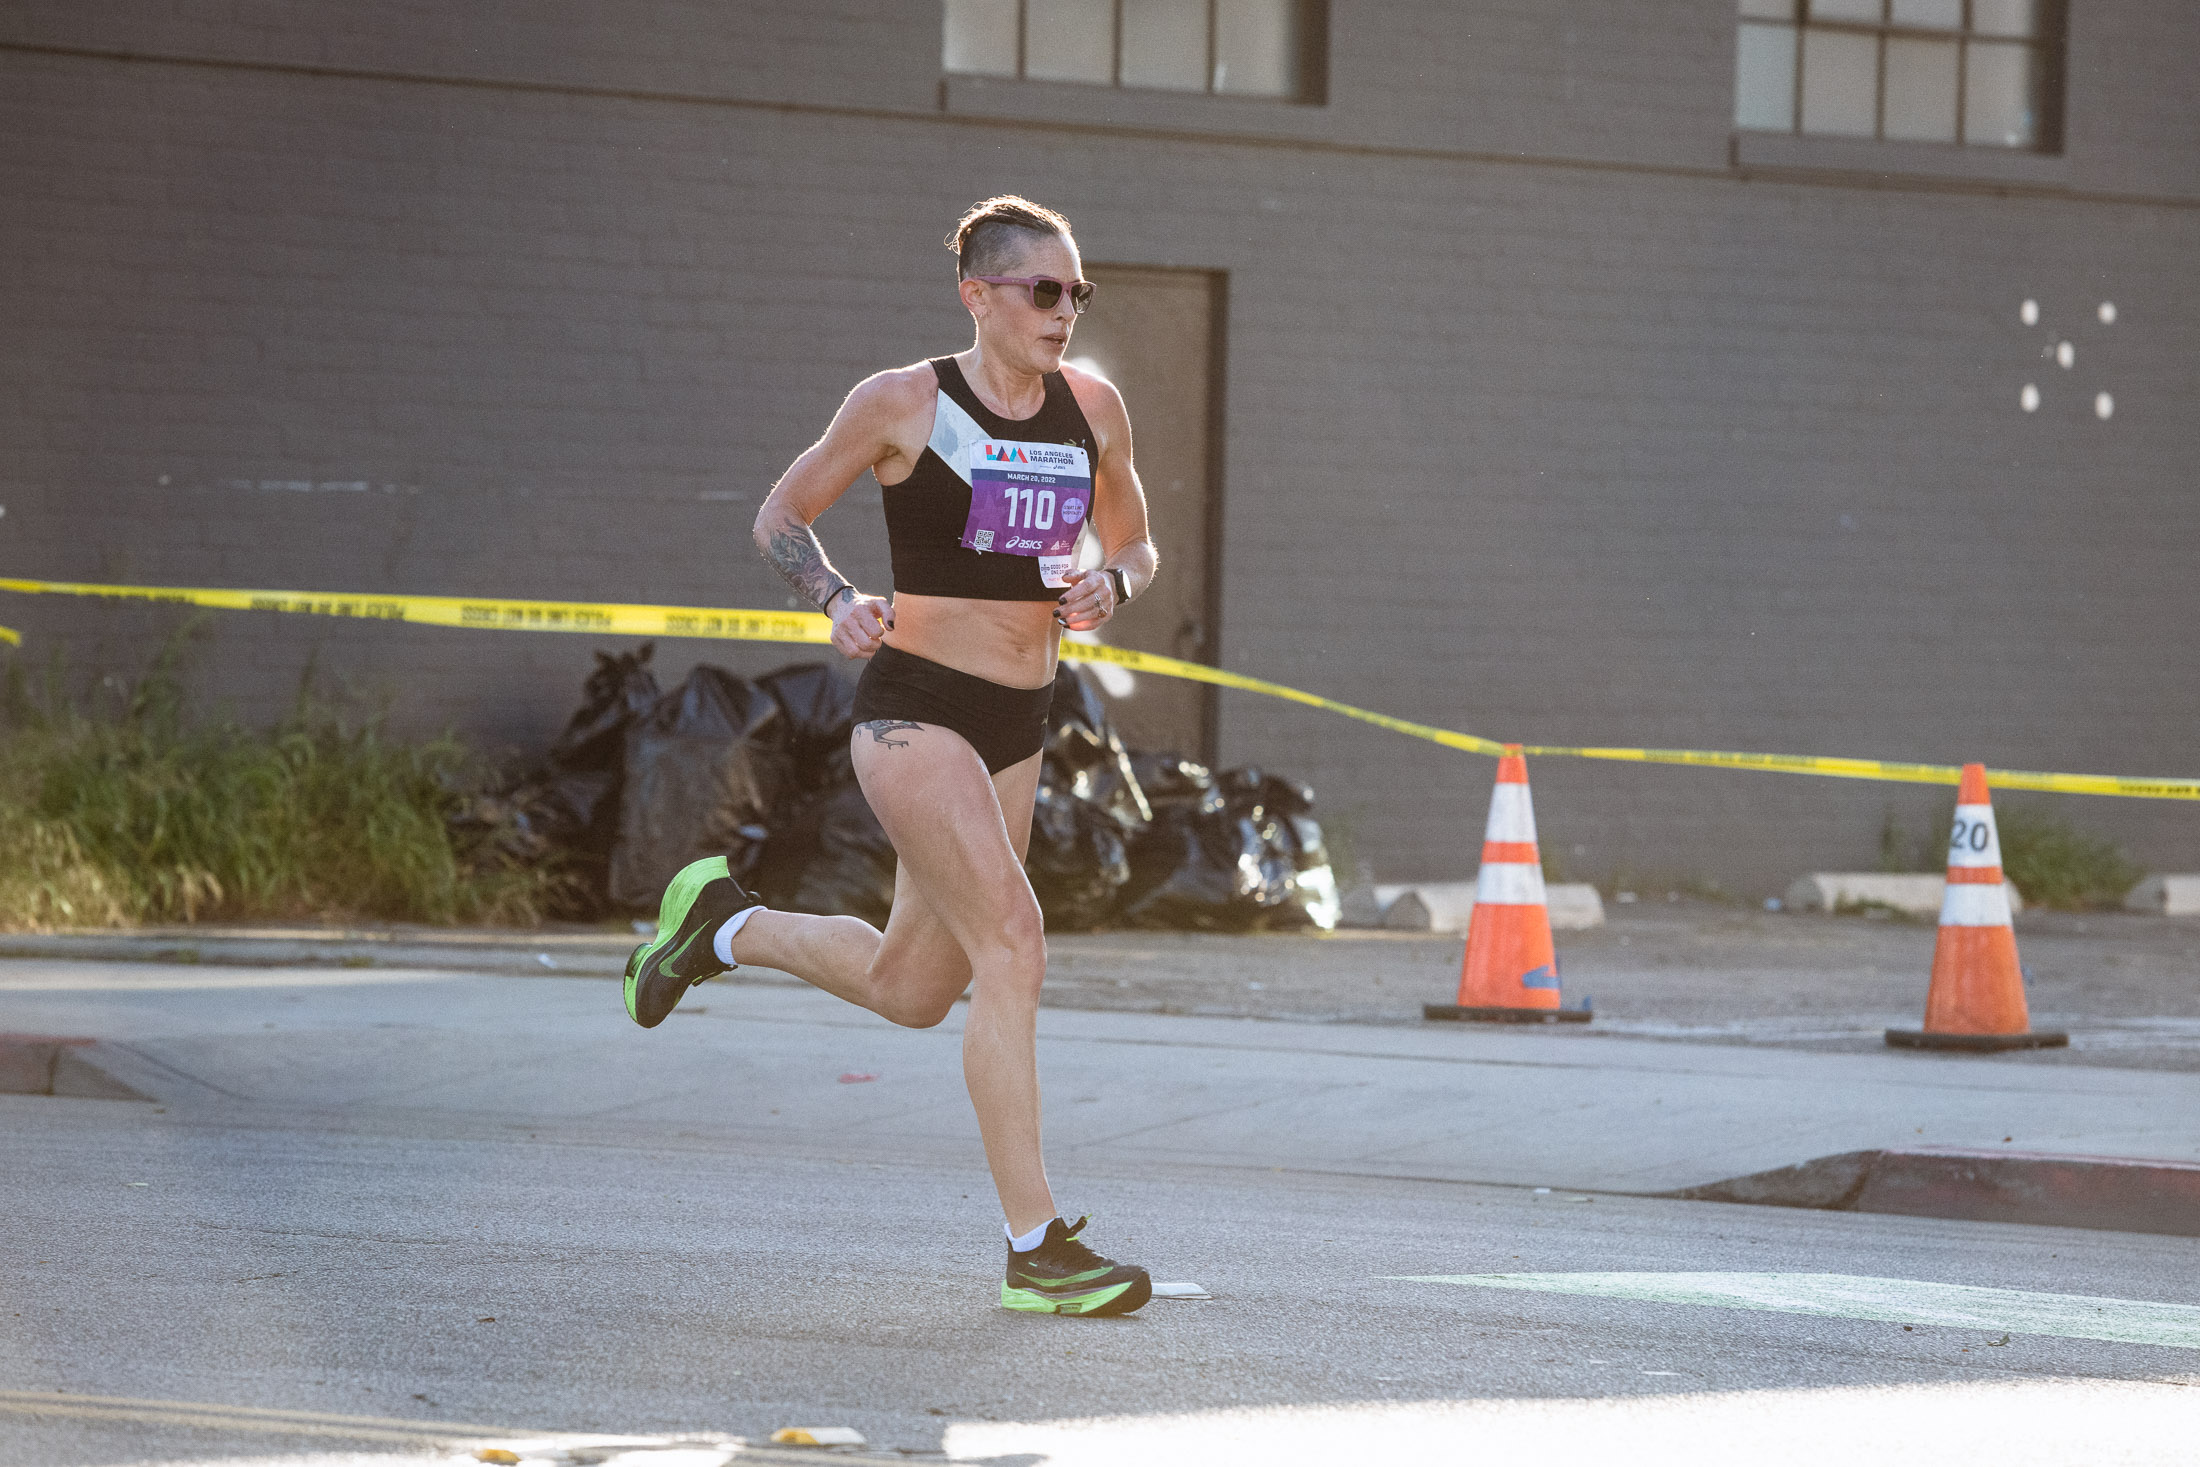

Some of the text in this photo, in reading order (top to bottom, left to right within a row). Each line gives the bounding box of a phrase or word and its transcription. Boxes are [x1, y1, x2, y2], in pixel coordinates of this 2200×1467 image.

[1030, 455, 1074, 465] MARATHON
[1044, 450, 1073, 459] ANGELES
[1007, 473, 1056, 484] MARCH 20, 2022
[1004, 487, 1056, 530] 110
[1951, 820, 1989, 852] 20
